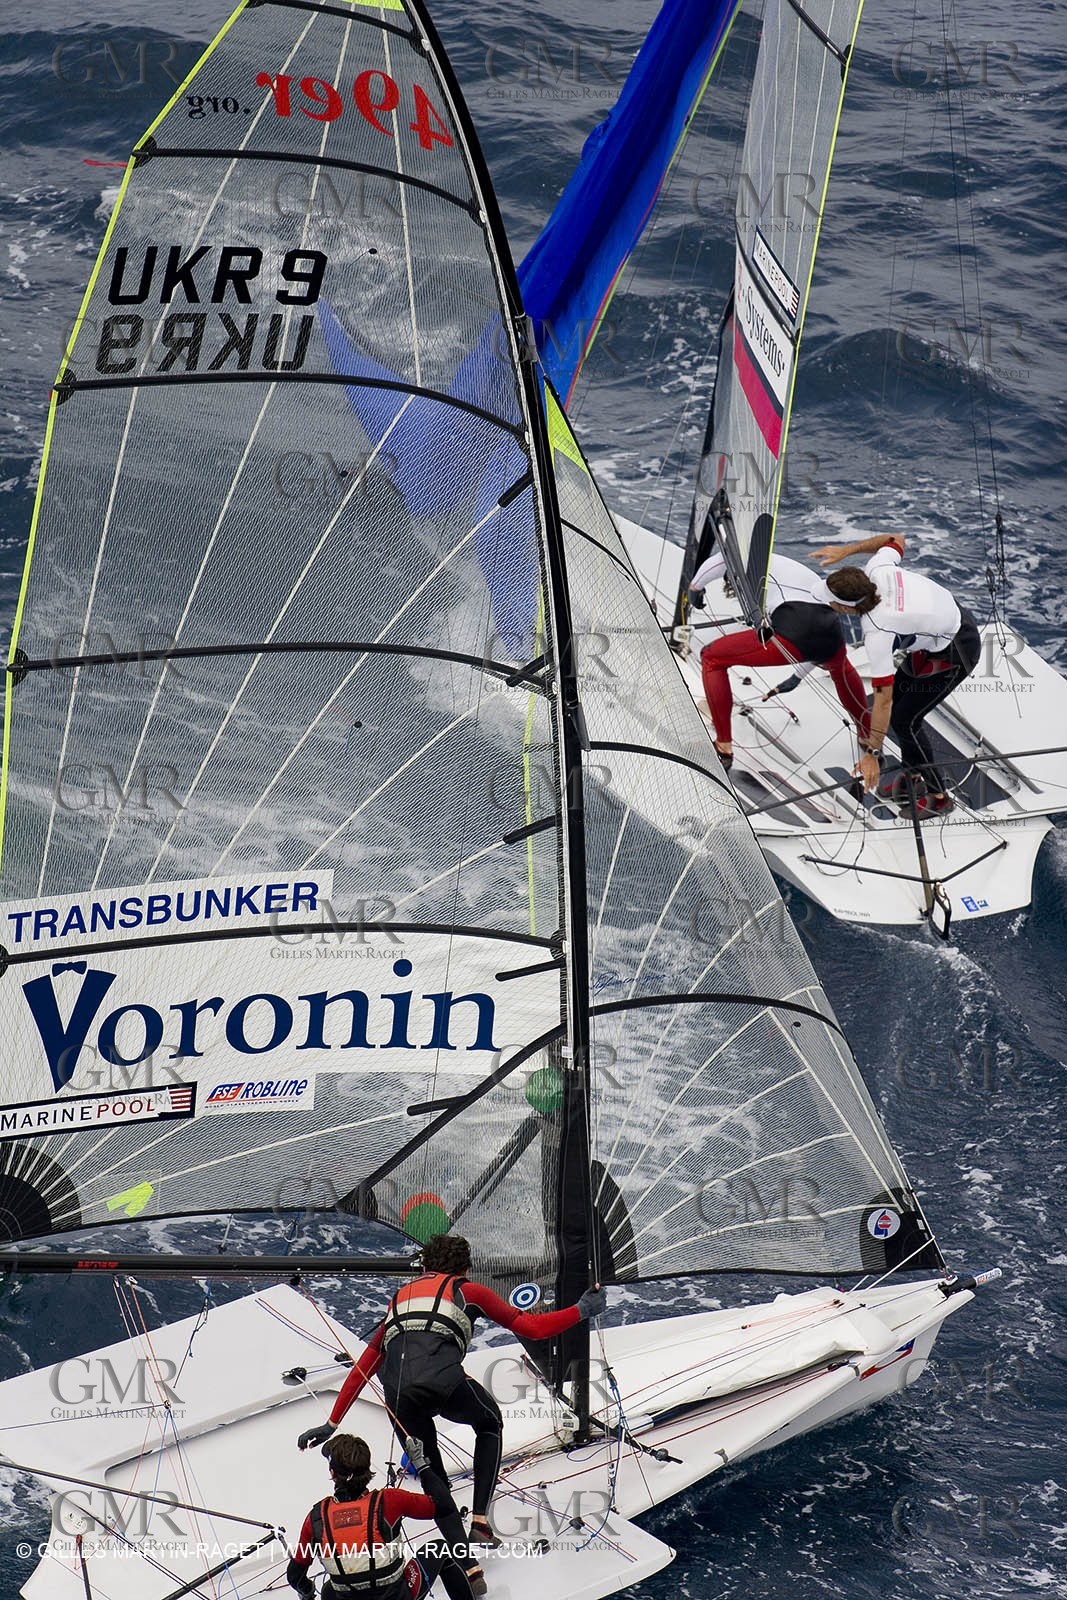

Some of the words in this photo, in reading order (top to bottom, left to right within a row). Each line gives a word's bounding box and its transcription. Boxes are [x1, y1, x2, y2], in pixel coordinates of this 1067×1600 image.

[108, 246, 263, 305] UKR
[275, 248, 328, 306] 9
[8, 881, 319, 943] TRANSBUNKER
[22, 959, 502, 1094] Voronin
[1, 1099, 156, 1131] MARINEPOOL
[212, 1085, 238, 1099] FSE
